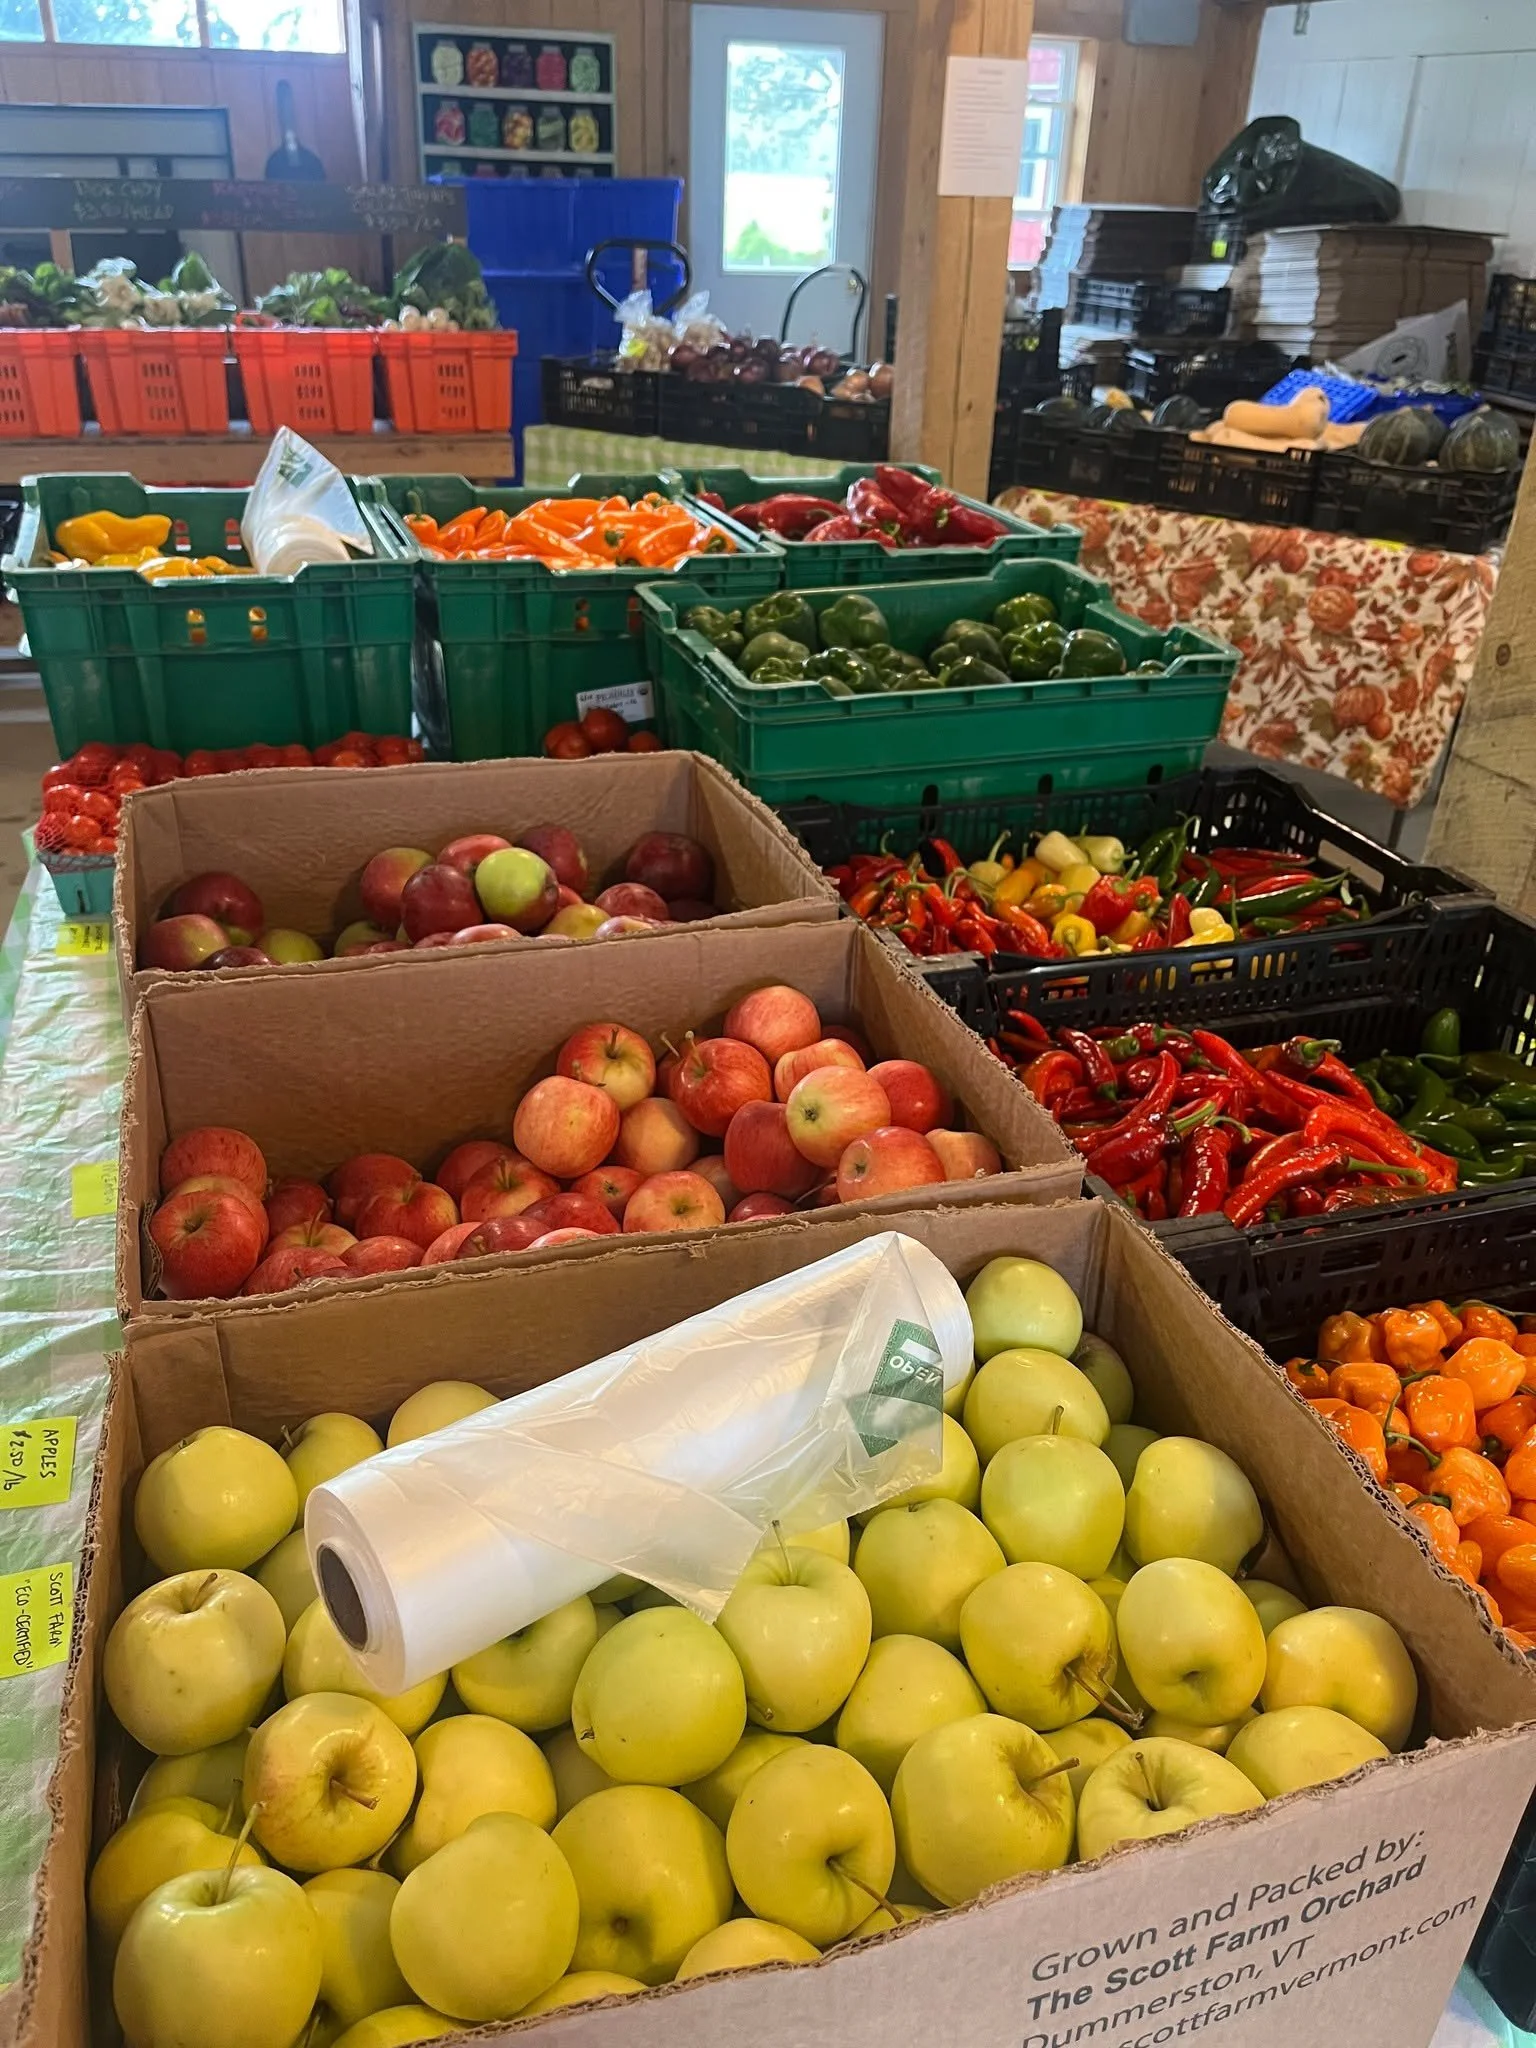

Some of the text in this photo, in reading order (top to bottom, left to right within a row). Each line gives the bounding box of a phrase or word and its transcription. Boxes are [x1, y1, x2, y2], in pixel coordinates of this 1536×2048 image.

[40, 1429, 60, 1479] APPLES
[48, 1571, 65, 1648] SCOTT FARM
[1026, 1854, 1427, 2021] The Scott Farm Orchard
[1031, 1829, 1425, 1982] Grown and Packed by:
[1022, 1933, 1316, 2048] Dummerston, VT
